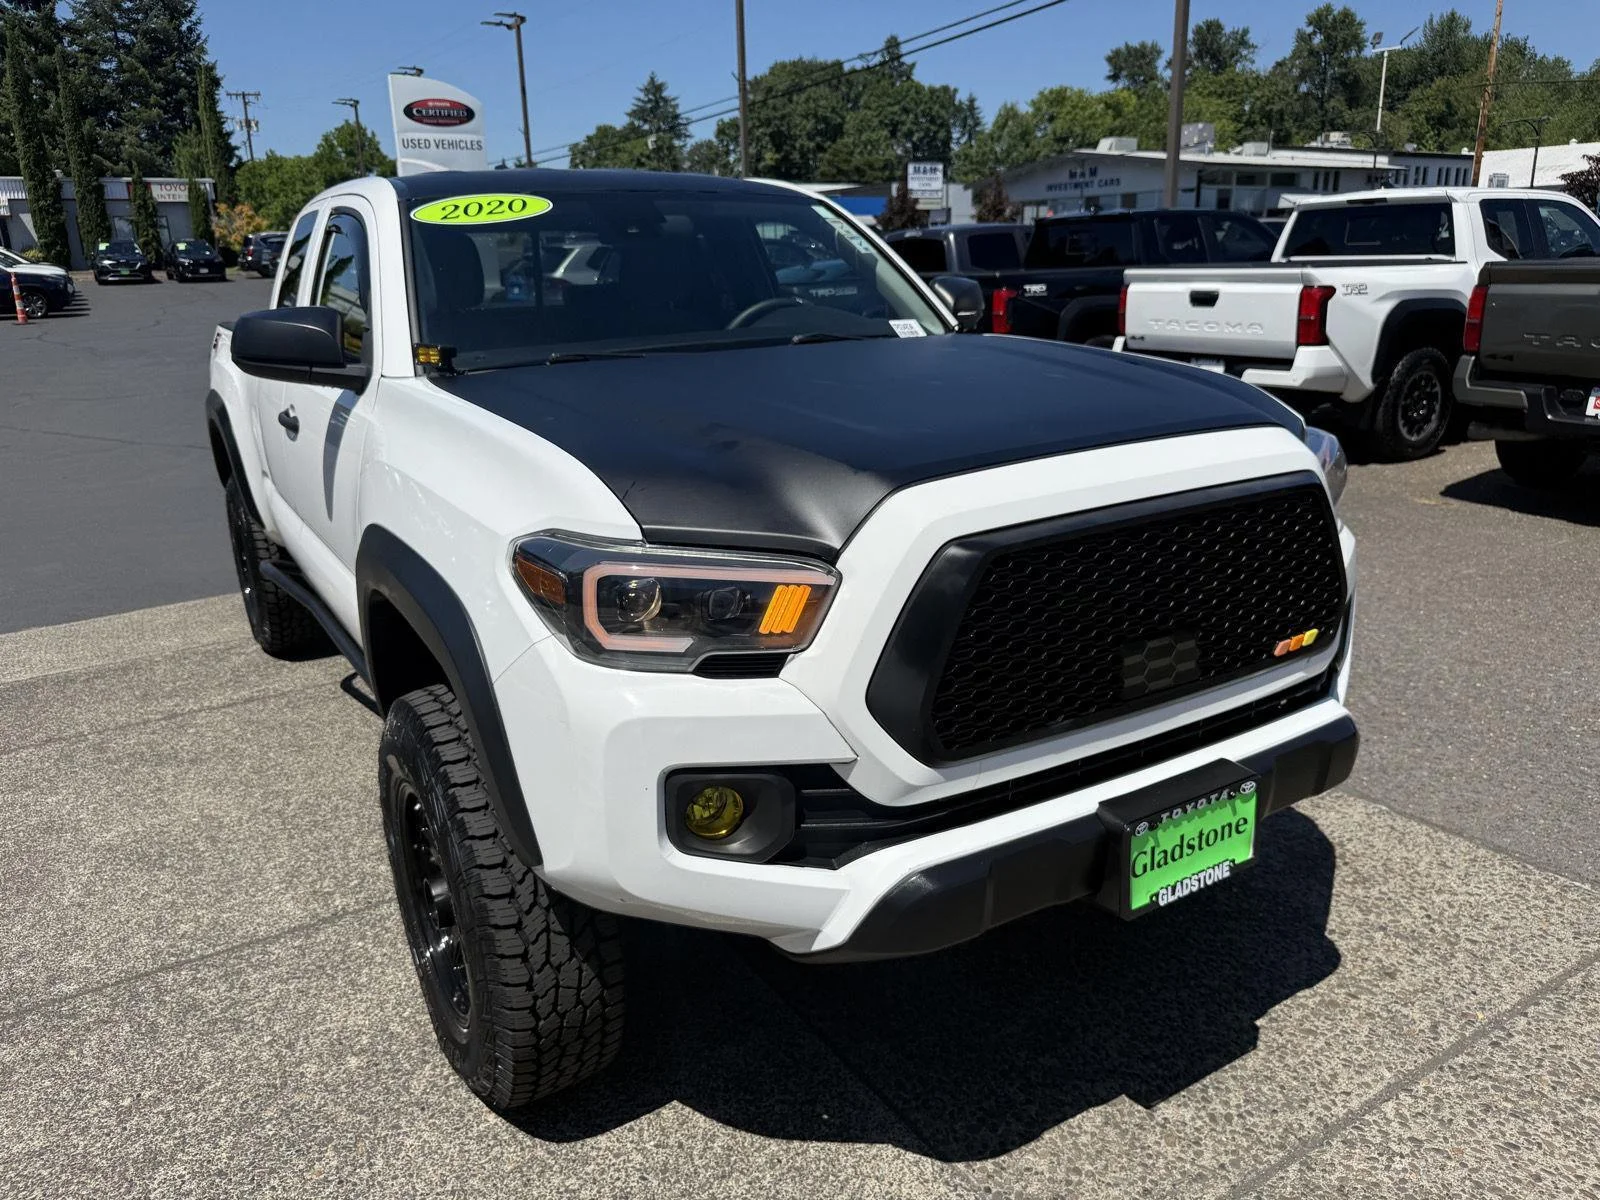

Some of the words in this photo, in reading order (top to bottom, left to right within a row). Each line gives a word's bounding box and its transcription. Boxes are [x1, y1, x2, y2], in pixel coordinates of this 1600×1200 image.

[402, 138, 431, 149] USED
[434, 139, 483, 151] VEHICLES
[160, 183, 187, 192] TOYO
[440, 198, 528, 221] 2020
[1147, 318, 1264, 335] TACOMA
[1160, 788, 1230, 823] TOYOTA
[1131, 817, 1248, 879] Gladstone
[1158, 860, 1230, 906] GLADSTONE
